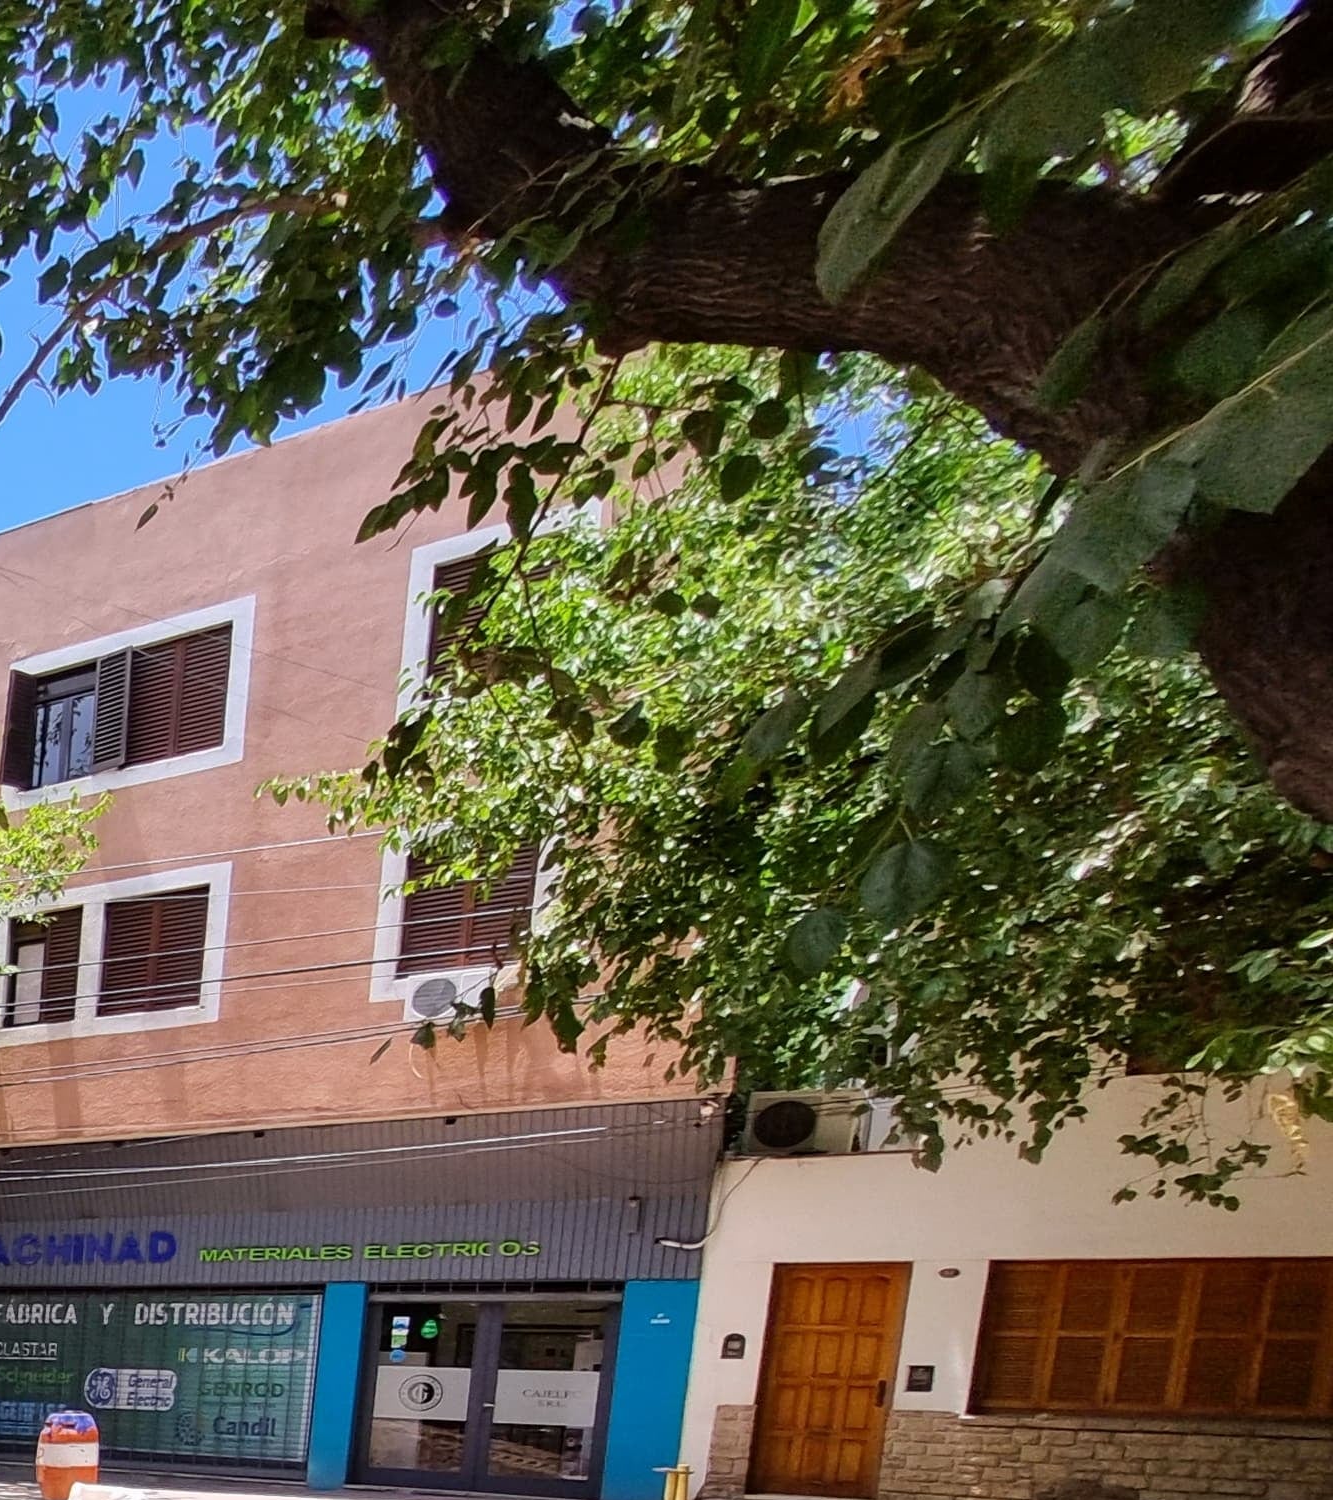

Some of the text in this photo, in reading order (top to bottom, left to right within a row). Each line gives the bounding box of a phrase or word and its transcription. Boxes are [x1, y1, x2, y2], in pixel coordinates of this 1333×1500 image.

[199, 1245, 353, 1262] MATERIALES
[100, 1303, 116, 1326] Y
[133, 1297, 294, 1326] DISTRIBUCIÓN
[203, 1347, 309, 1364] KALOP
[128, 1374, 174, 1389] General
[198, 1380, 285, 1398] GENROD
[213, 1415, 277, 1437] Candil
